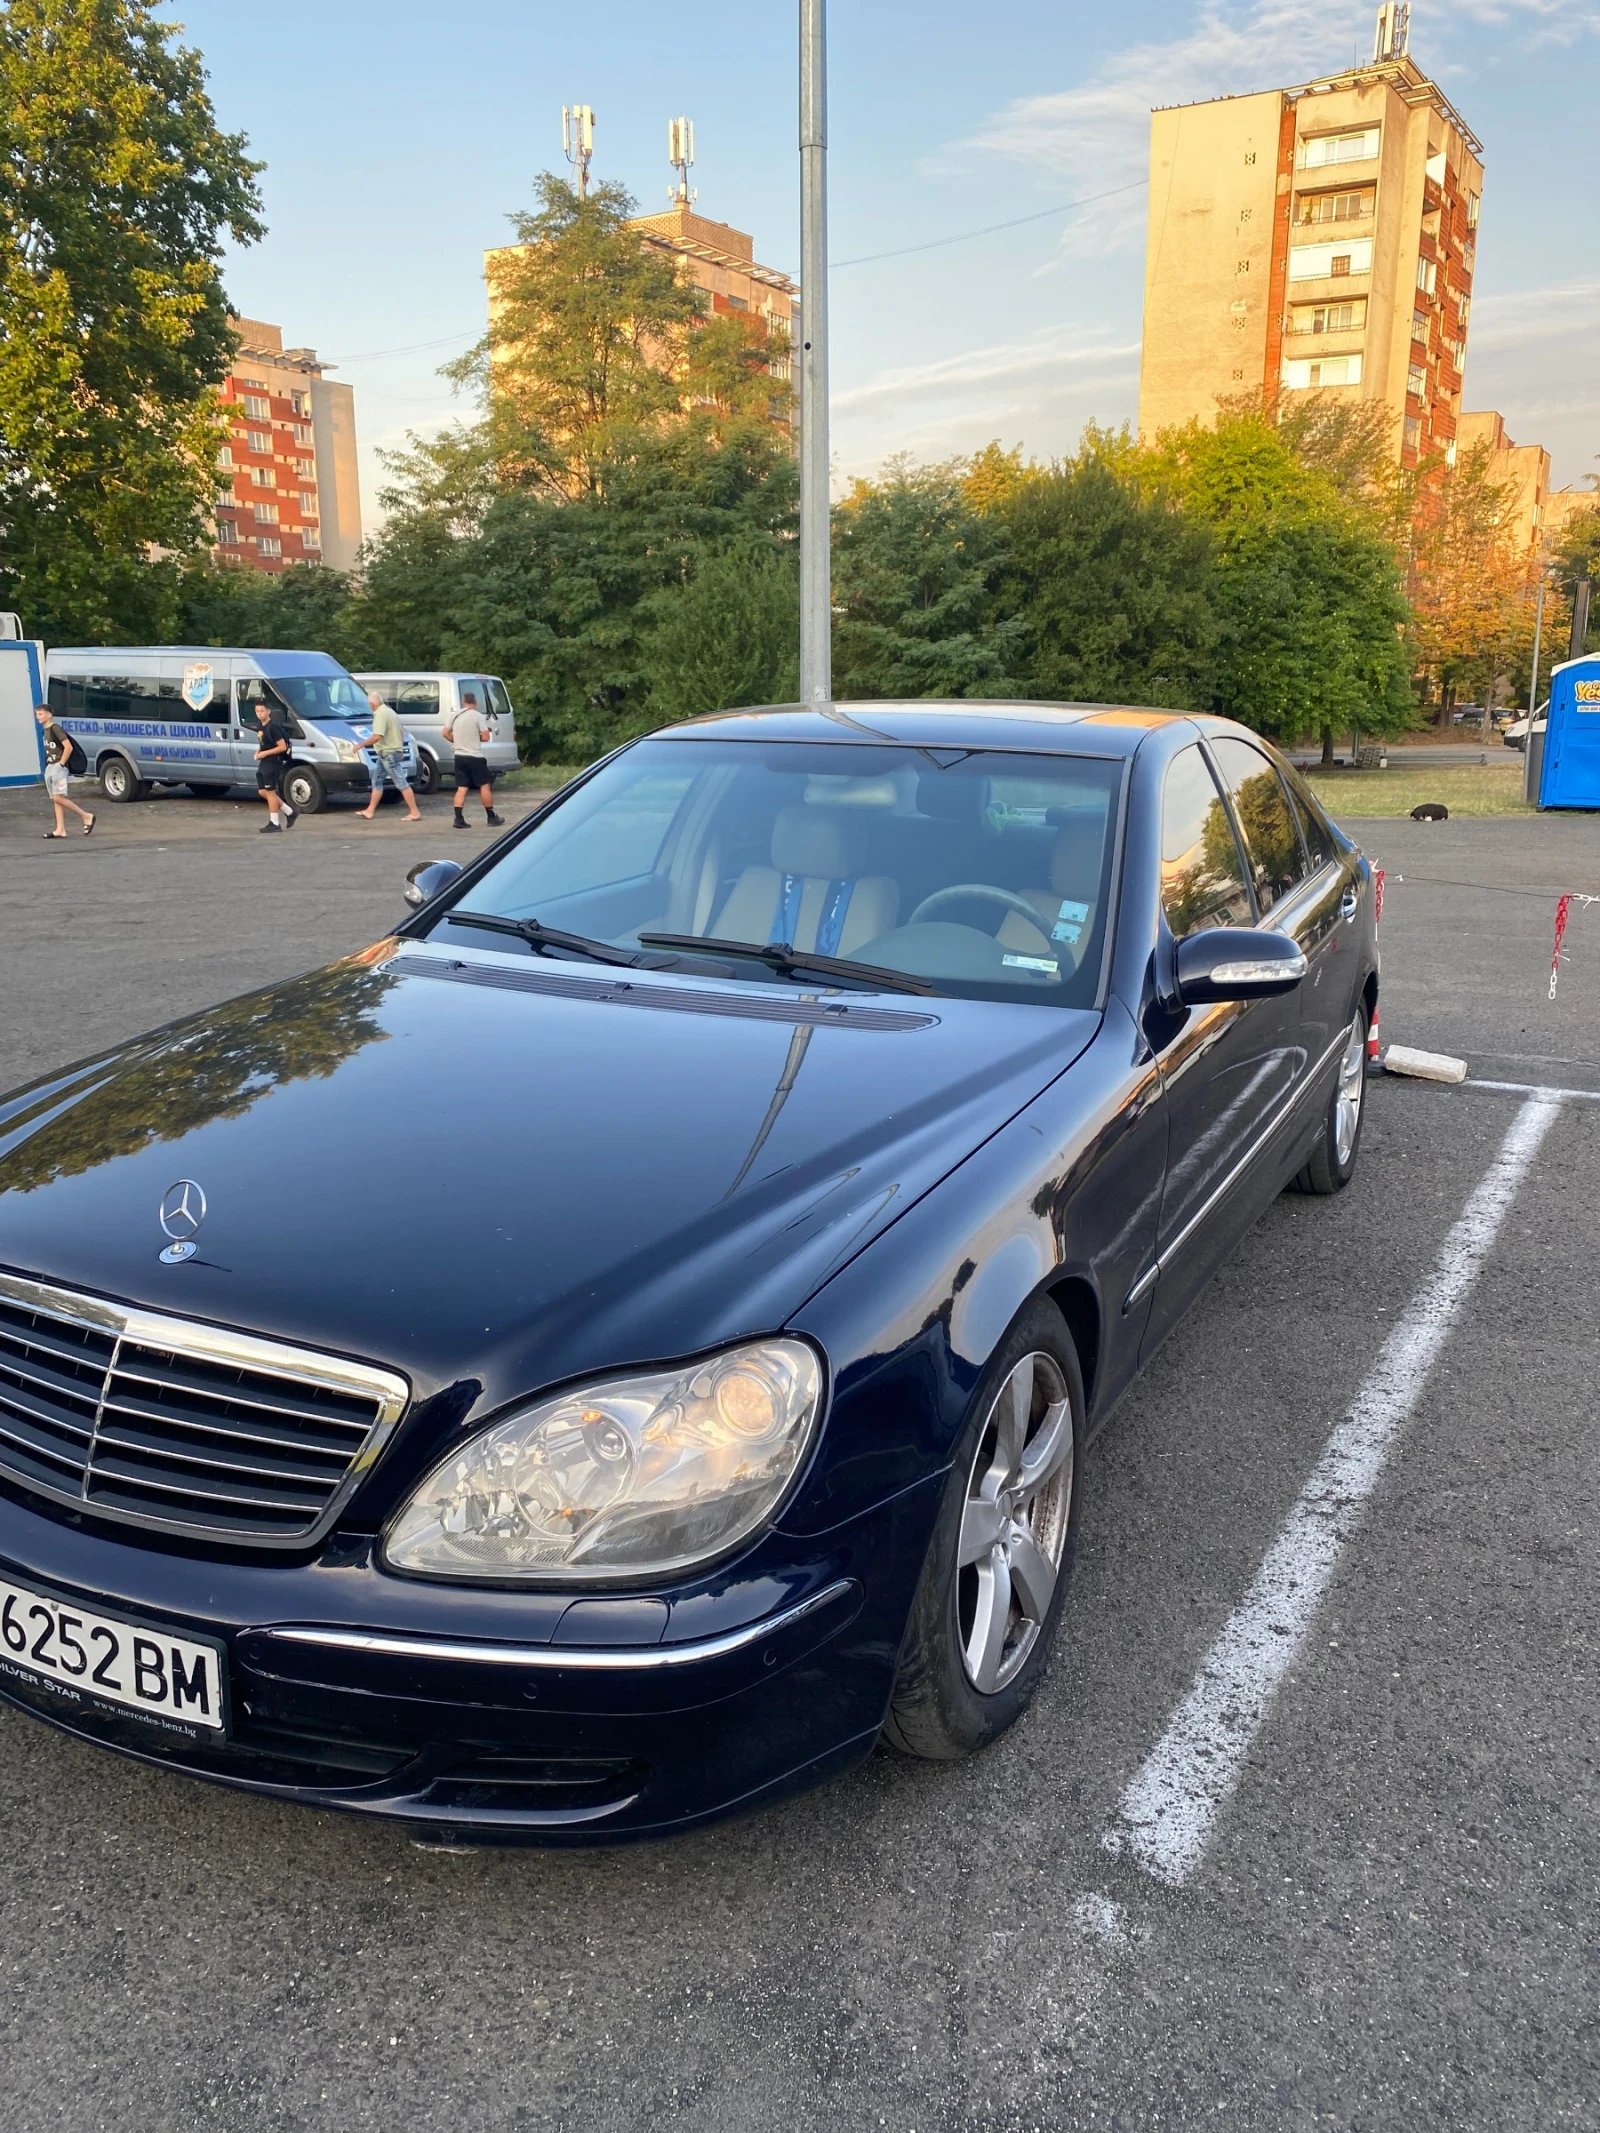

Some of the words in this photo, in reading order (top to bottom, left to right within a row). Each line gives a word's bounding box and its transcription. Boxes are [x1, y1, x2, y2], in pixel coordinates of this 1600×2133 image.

[189, 675, 208, 690] АРДА
[170, 724, 211, 738] ШКОЛА
[2, 1594, 122, 1691] 6252
[93, 1699, 197, 1738] www.mercedes-benz.bg
